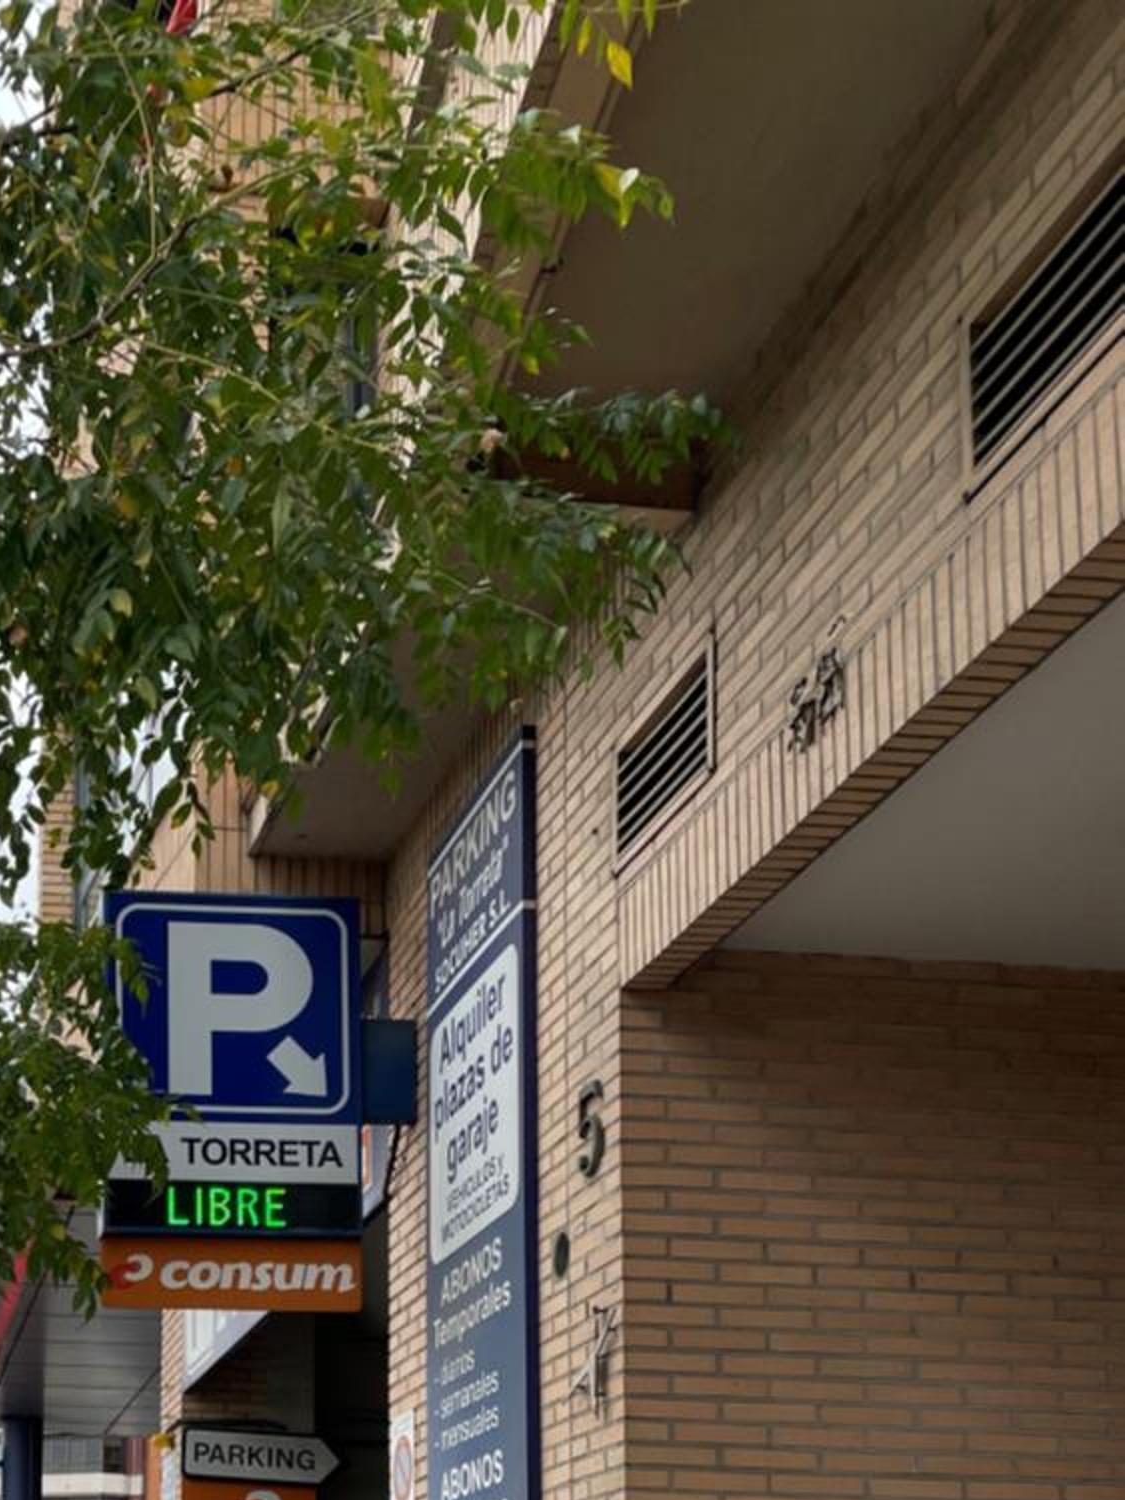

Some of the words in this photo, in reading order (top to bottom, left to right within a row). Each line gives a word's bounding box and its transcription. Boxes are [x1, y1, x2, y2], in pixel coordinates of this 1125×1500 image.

[429, 768, 517, 921] PARKING
[167, 920, 314, 1096] P
[439, 974, 506, 1075] Alquiler
[434, 1053, 486, 1145] plazas
[490, 1024, 513, 1076] de
[180, 1136, 344, 1169] TORRETA
[446, 1096, 499, 1185] garaje
[578, 1078, 606, 1179] 5
[167, 1186, 288, 1229] LIBRE
[160, 1253, 356, 1293] consum
[440, 1237, 503, 1305] ABONOS
[433, 1280, 512, 1350] Temporales
[440, 1371, 500, 1420] semanales
[440, 1405, 500, 1451] mensuales
[193, 1442, 317, 1471] PARKING
